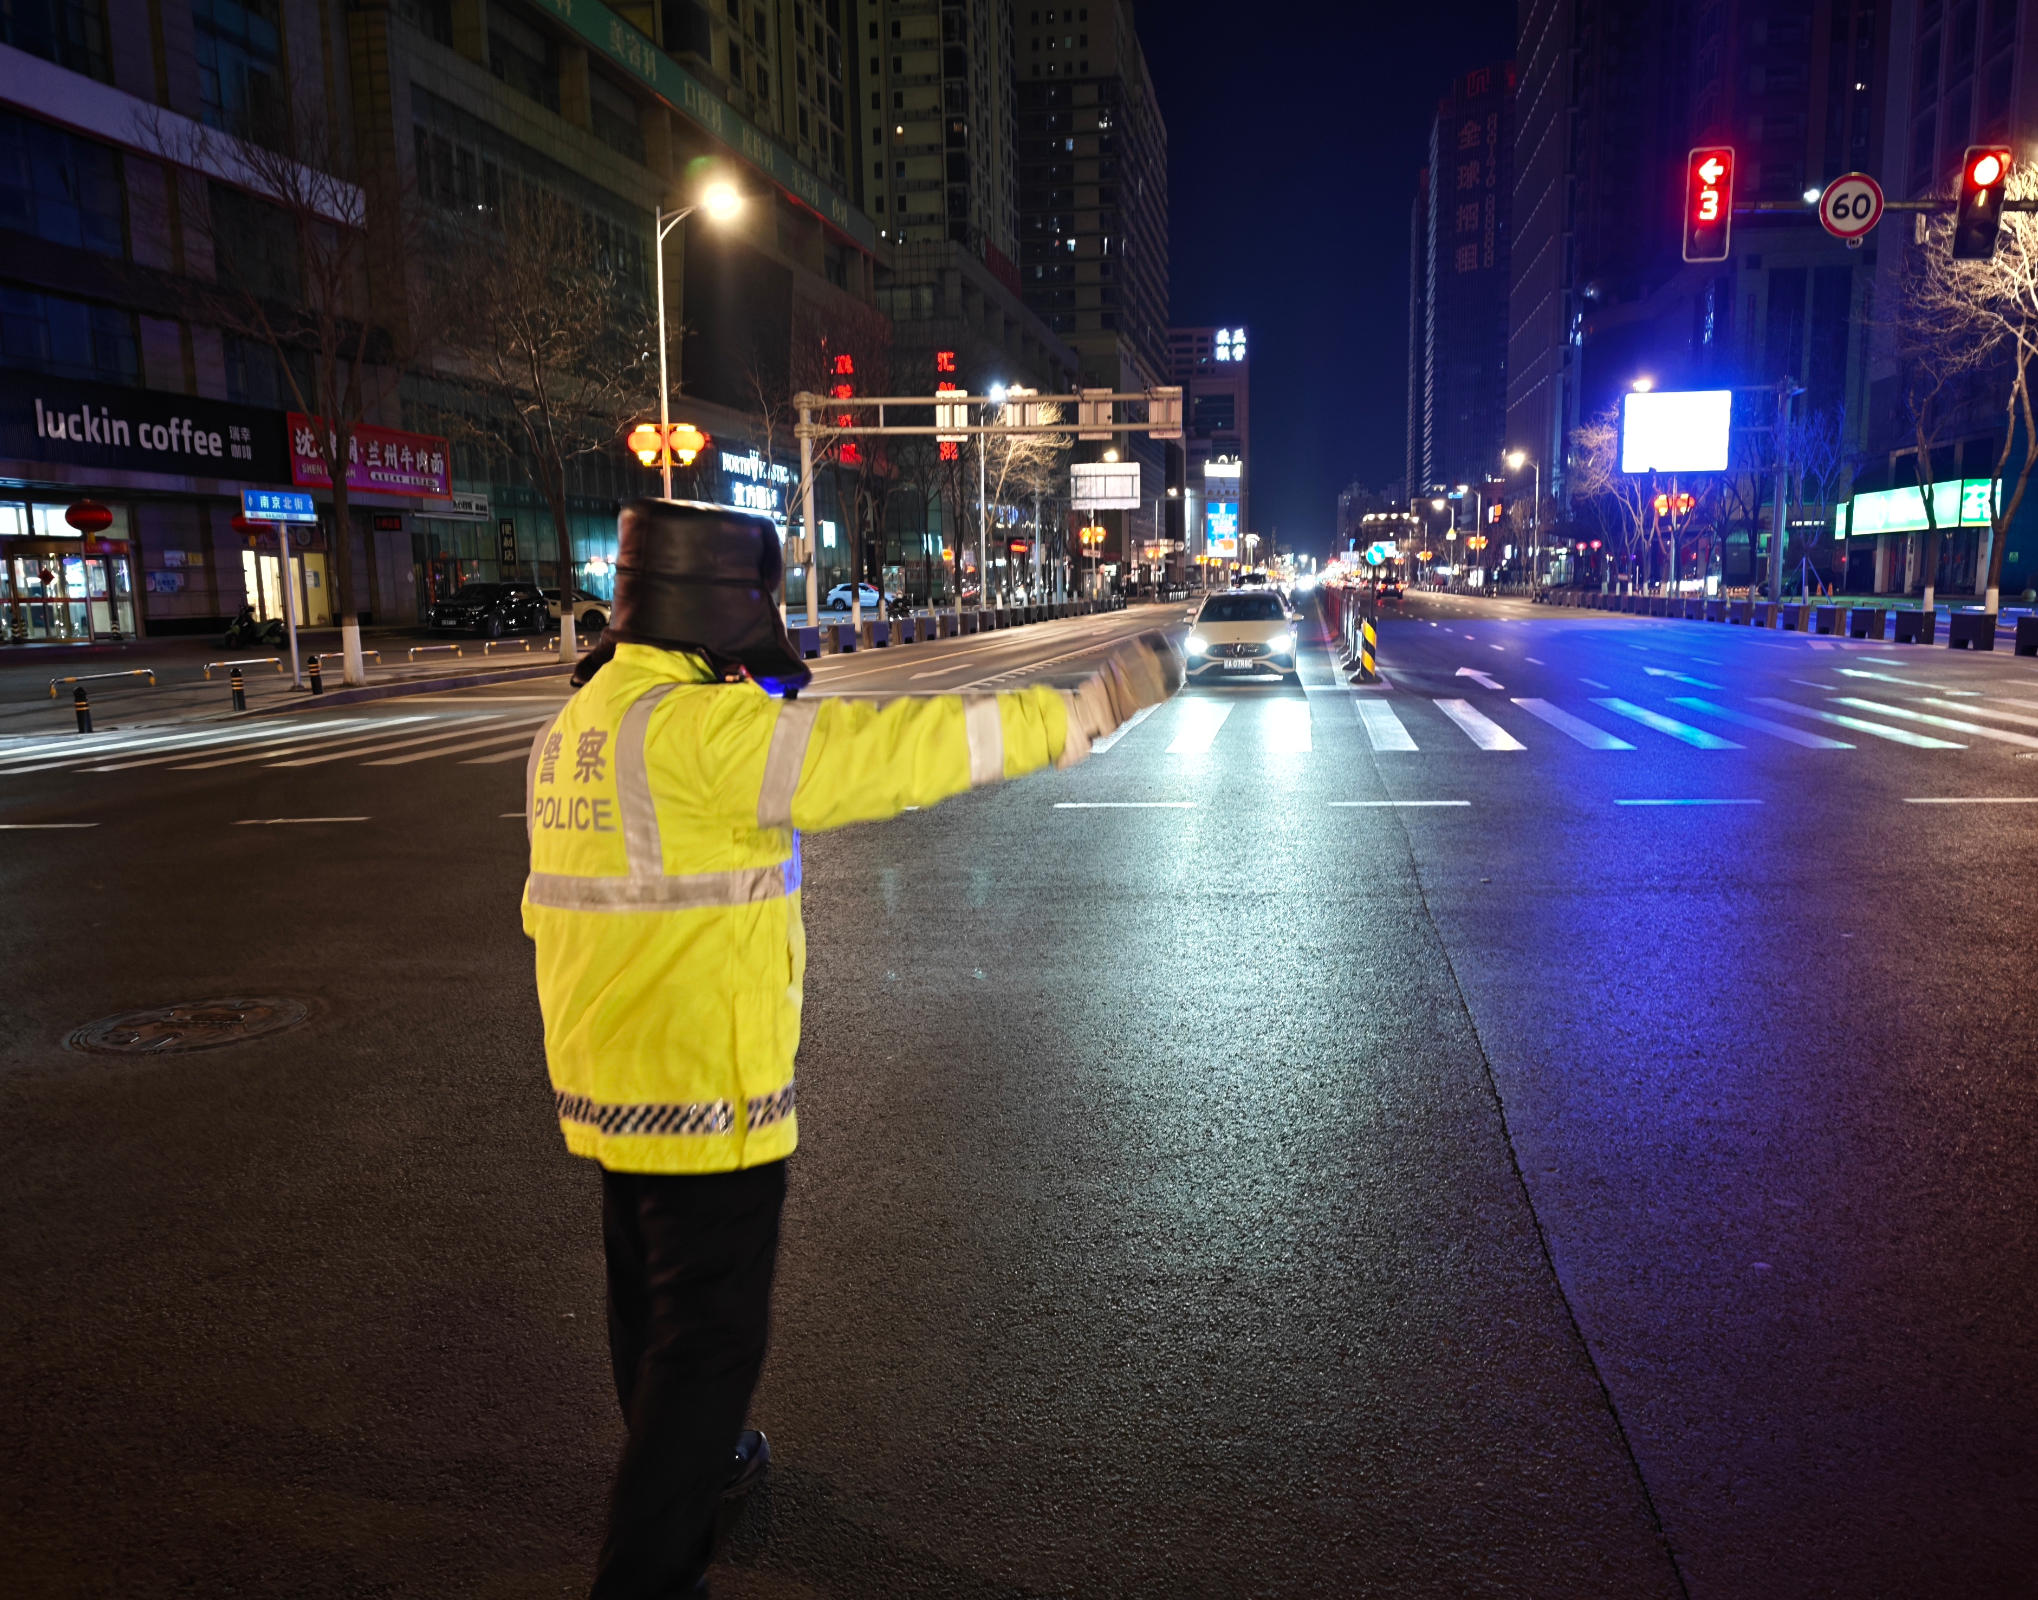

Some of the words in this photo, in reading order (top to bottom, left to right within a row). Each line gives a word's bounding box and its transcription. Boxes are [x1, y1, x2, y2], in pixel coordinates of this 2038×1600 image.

[1699, 190, 1719, 220] 3
[1832, 193, 1871, 220] 60
[34, 398, 131, 448] luckin
[138, 416, 223, 458] coffee
[259, 494, 303, 512] 南京北街
[540, 726, 608, 784] 警察
[534, 796, 616, 832] POLICE
